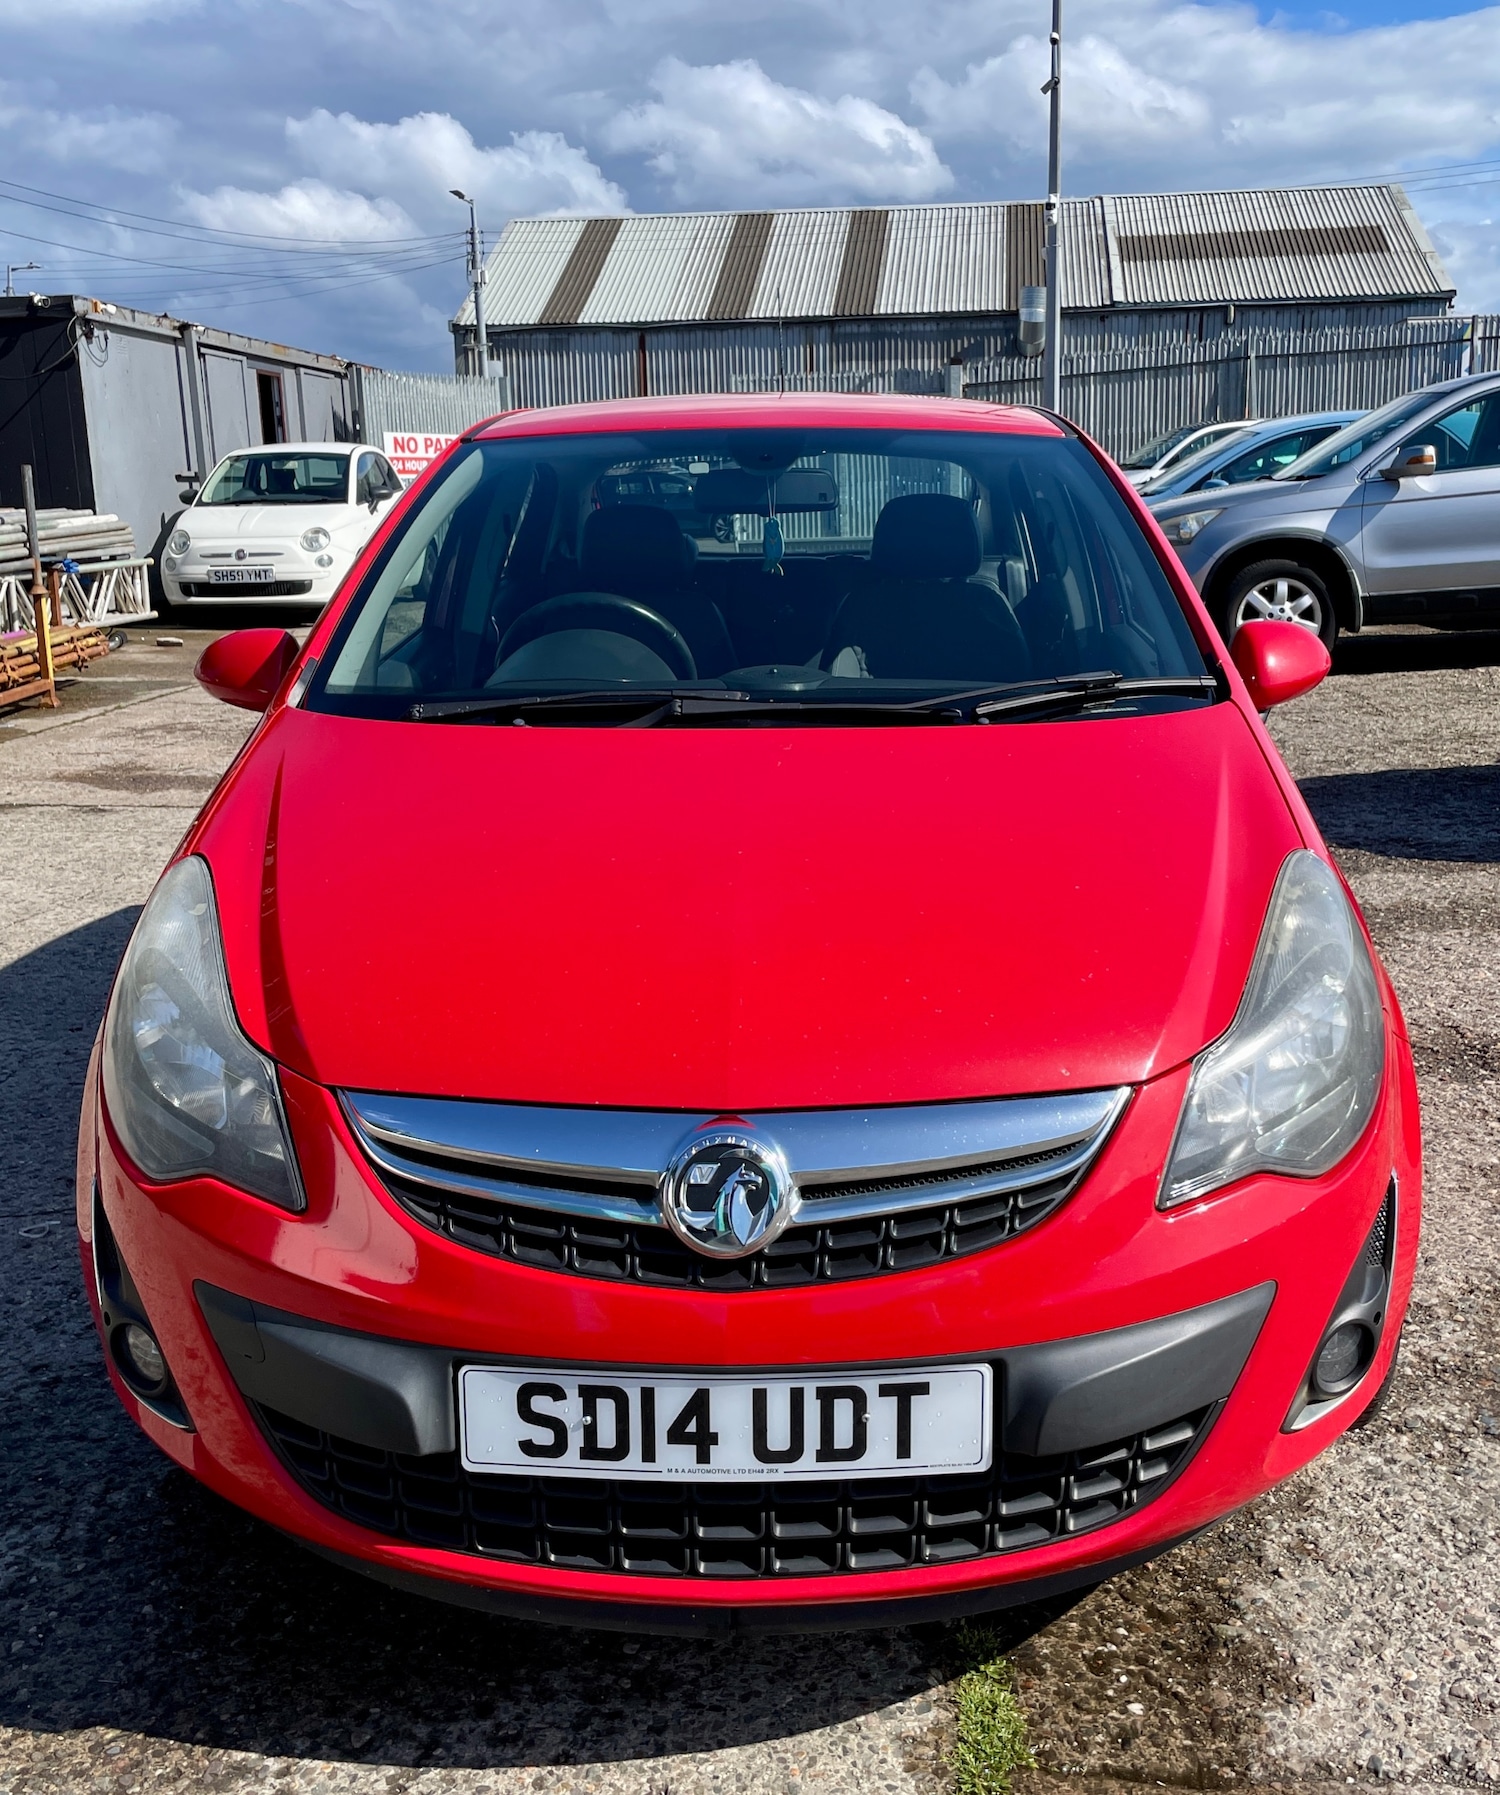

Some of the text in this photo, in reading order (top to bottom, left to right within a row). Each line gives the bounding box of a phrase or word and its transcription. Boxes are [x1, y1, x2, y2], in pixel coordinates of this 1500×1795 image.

[393, 436, 418, 454] NO
[214, 570, 244, 582] SH59
[516, 1381, 930, 1465] SD14 UDT
